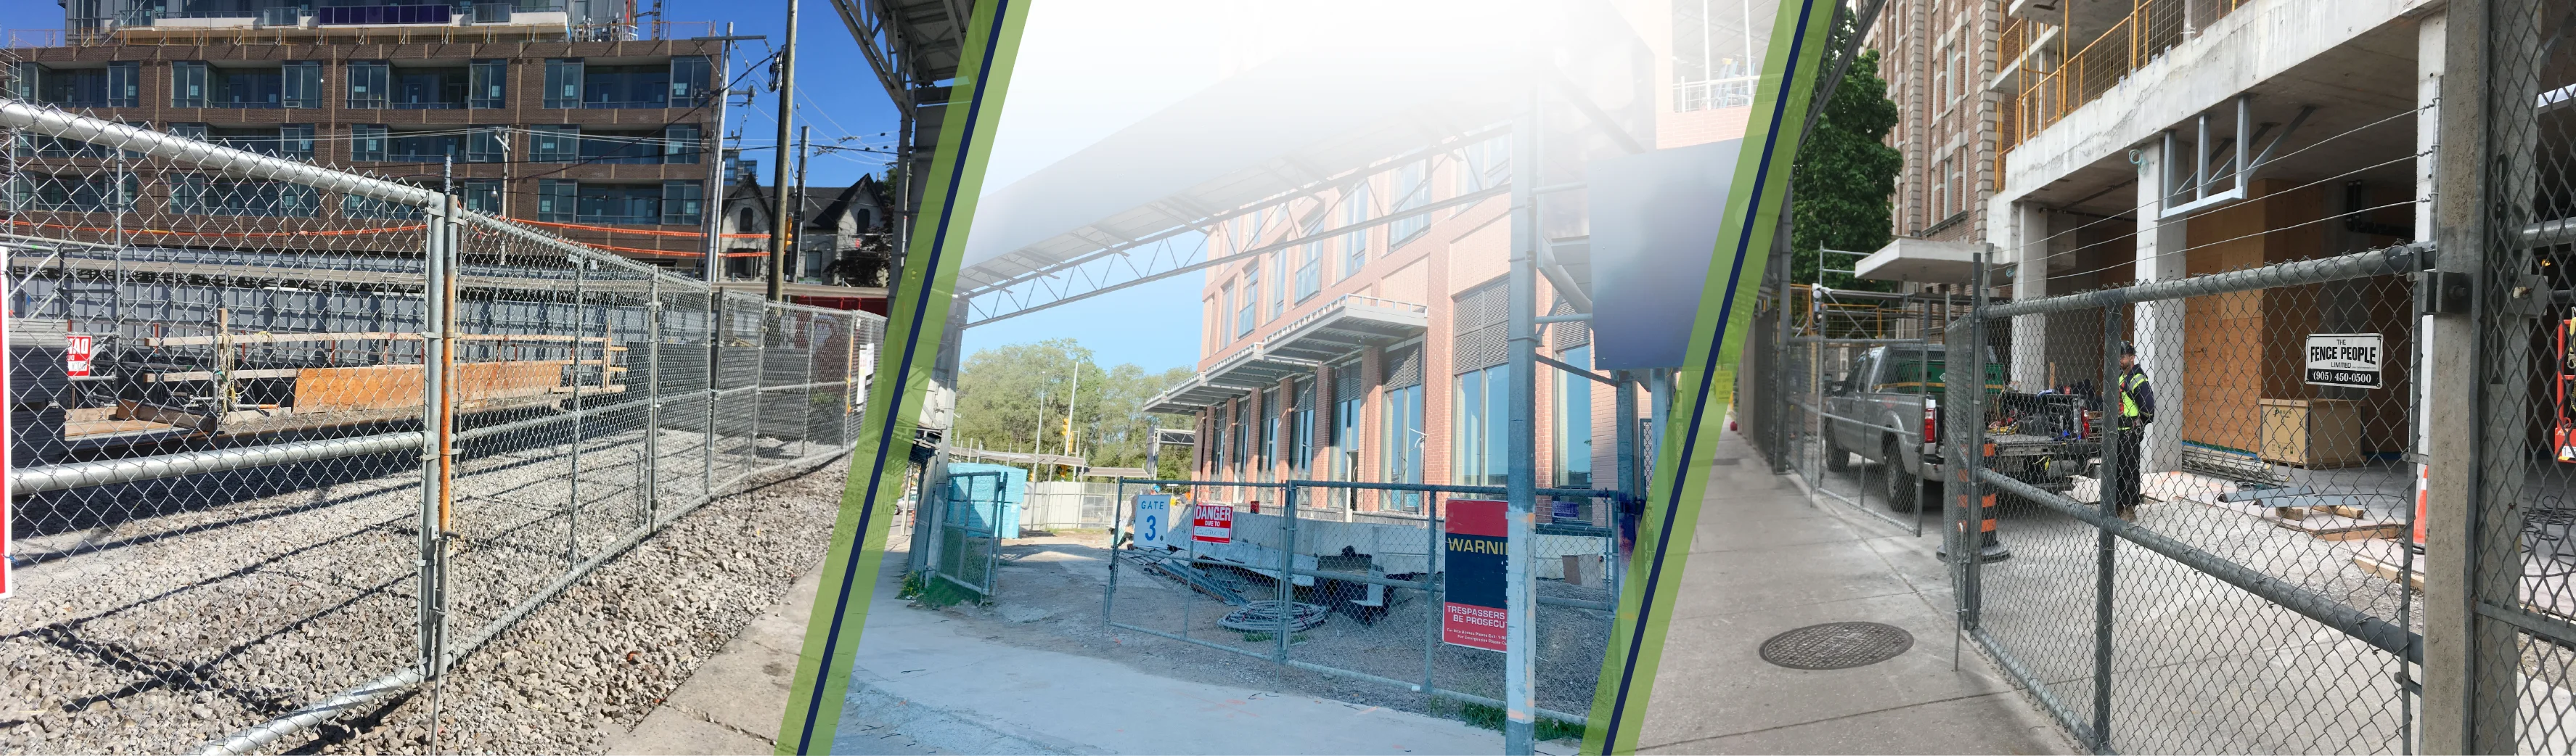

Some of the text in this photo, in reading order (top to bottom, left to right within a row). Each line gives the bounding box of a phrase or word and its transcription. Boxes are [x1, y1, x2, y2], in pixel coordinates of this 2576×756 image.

[2310, 346, 2376, 365] FENCE PEOPLE
[2313, 371, 2372, 383] (905) 450-0500
[1141, 501, 1165, 510] GATE
[1195, 506, 1231, 522] DANGER
[1145, 514, 1156, 541] 3
[1447, 537, 1508, 556] WARNI
[1447, 605, 1505, 620] TRESPASSERS
[1465, 616, 1508, 628] PROSECU
